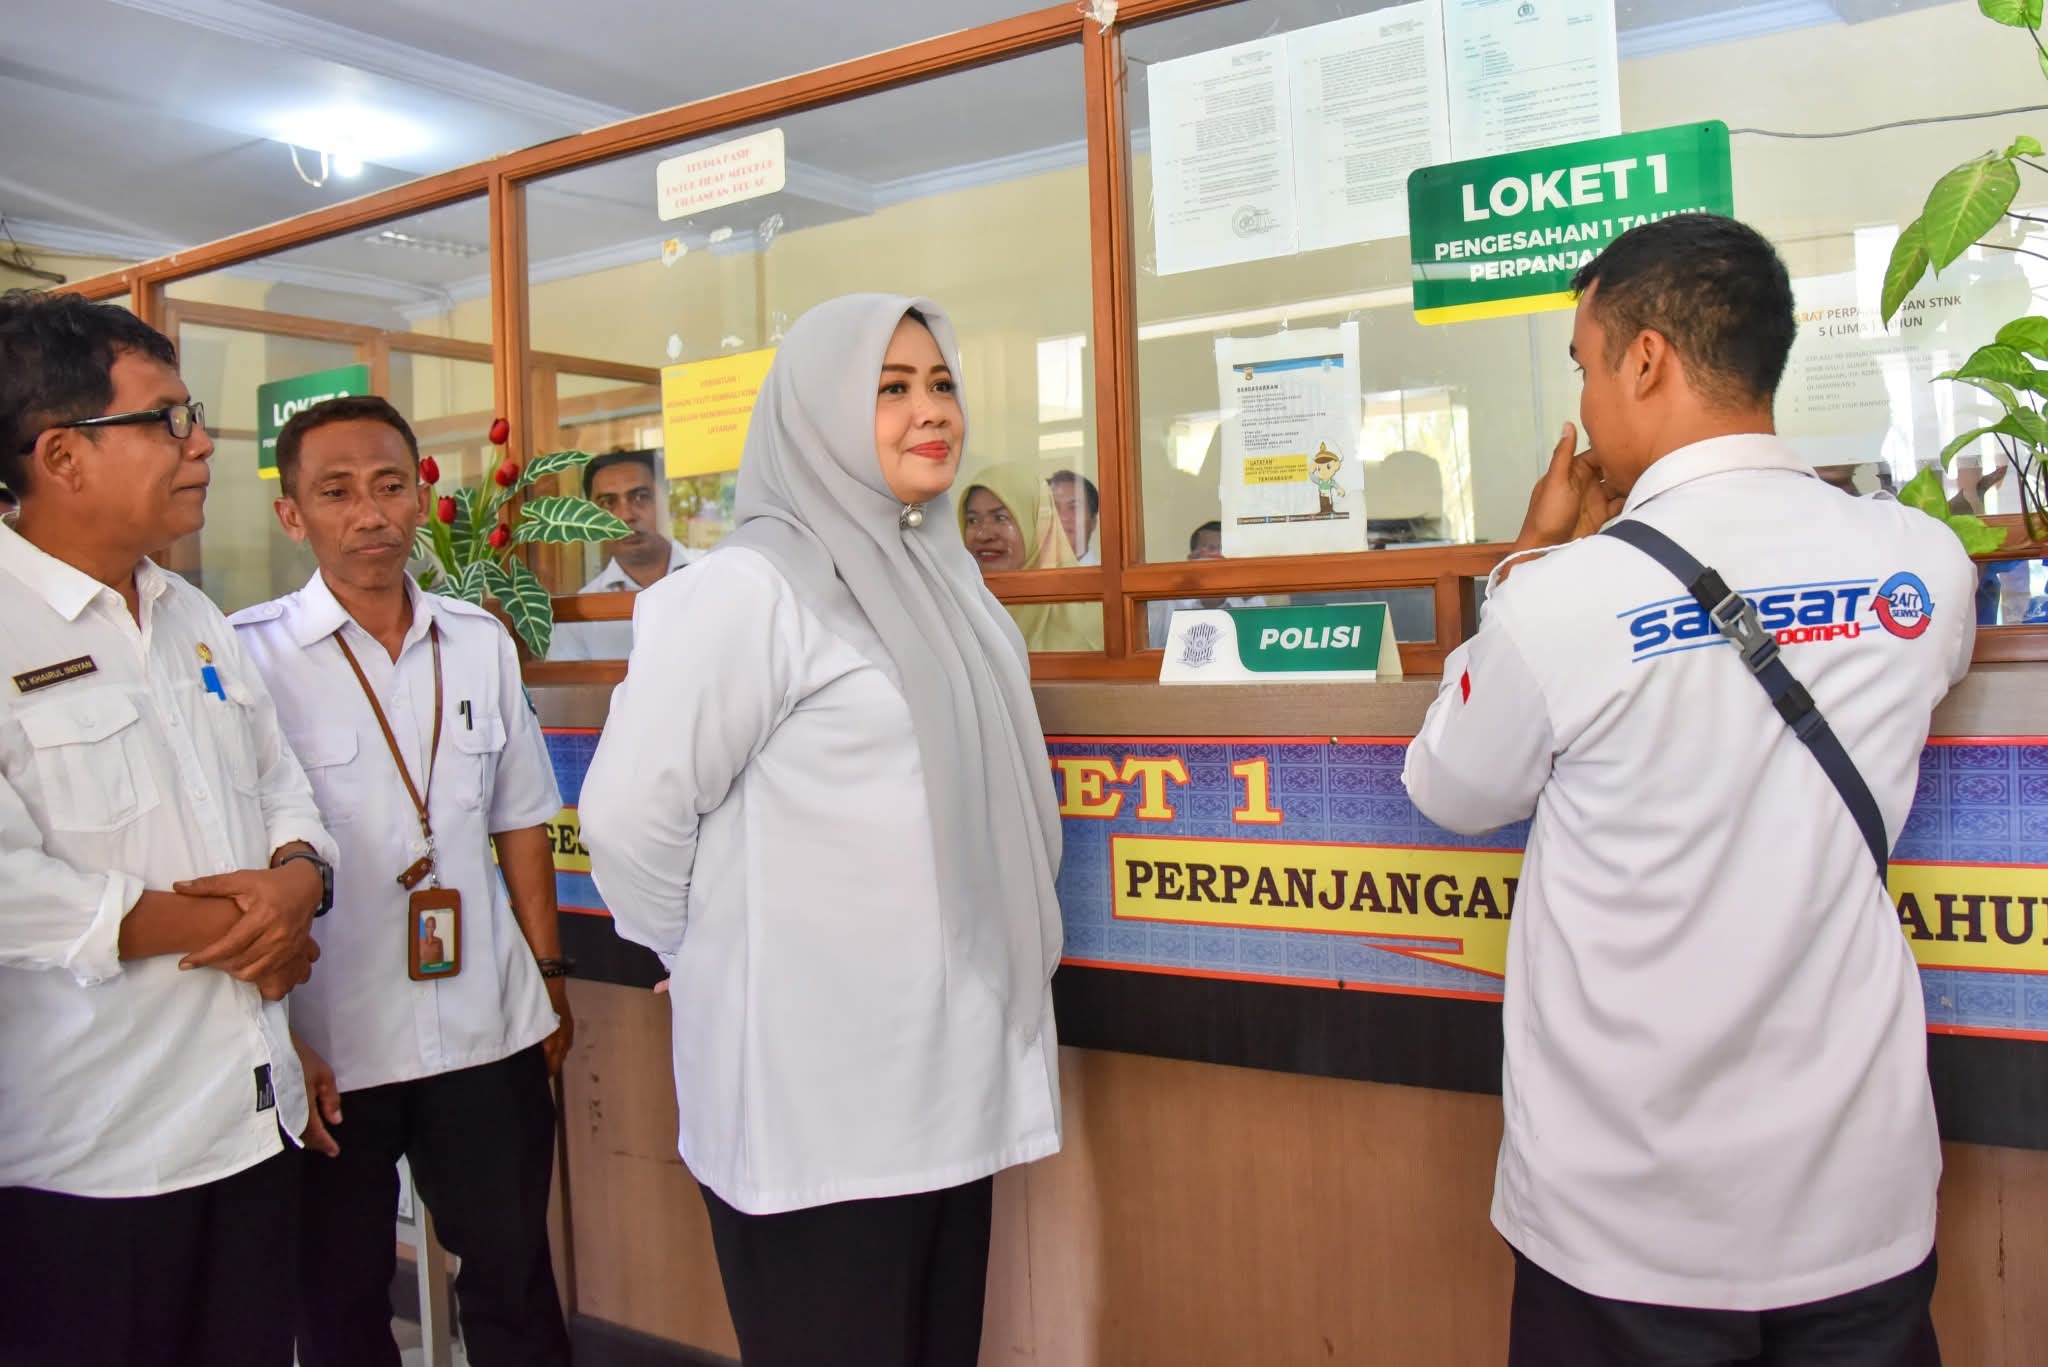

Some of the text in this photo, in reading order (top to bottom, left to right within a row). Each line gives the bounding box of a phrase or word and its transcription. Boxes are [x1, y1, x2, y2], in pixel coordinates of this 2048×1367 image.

[1462, 158, 1637, 222] LOKET
[1647, 154, 1668, 194] 1
[1435, 220, 1599, 261] PENGESAHAN
[1602, 219, 1613, 238] 1
[1470, 247, 1604, 282] PERPANJA
[1929, 295, 1962, 309] STNK
[1890, 592, 1919, 609] 24/7
[1892, 609, 1919, 617] SERVICE
[1259, 626, 1362, 651] POLISI
[1776, 622, 1860, 646] DOMPU
[1049, 757, 1283, 825] ET 1
[1895, 892, 2048, 945] AHU
